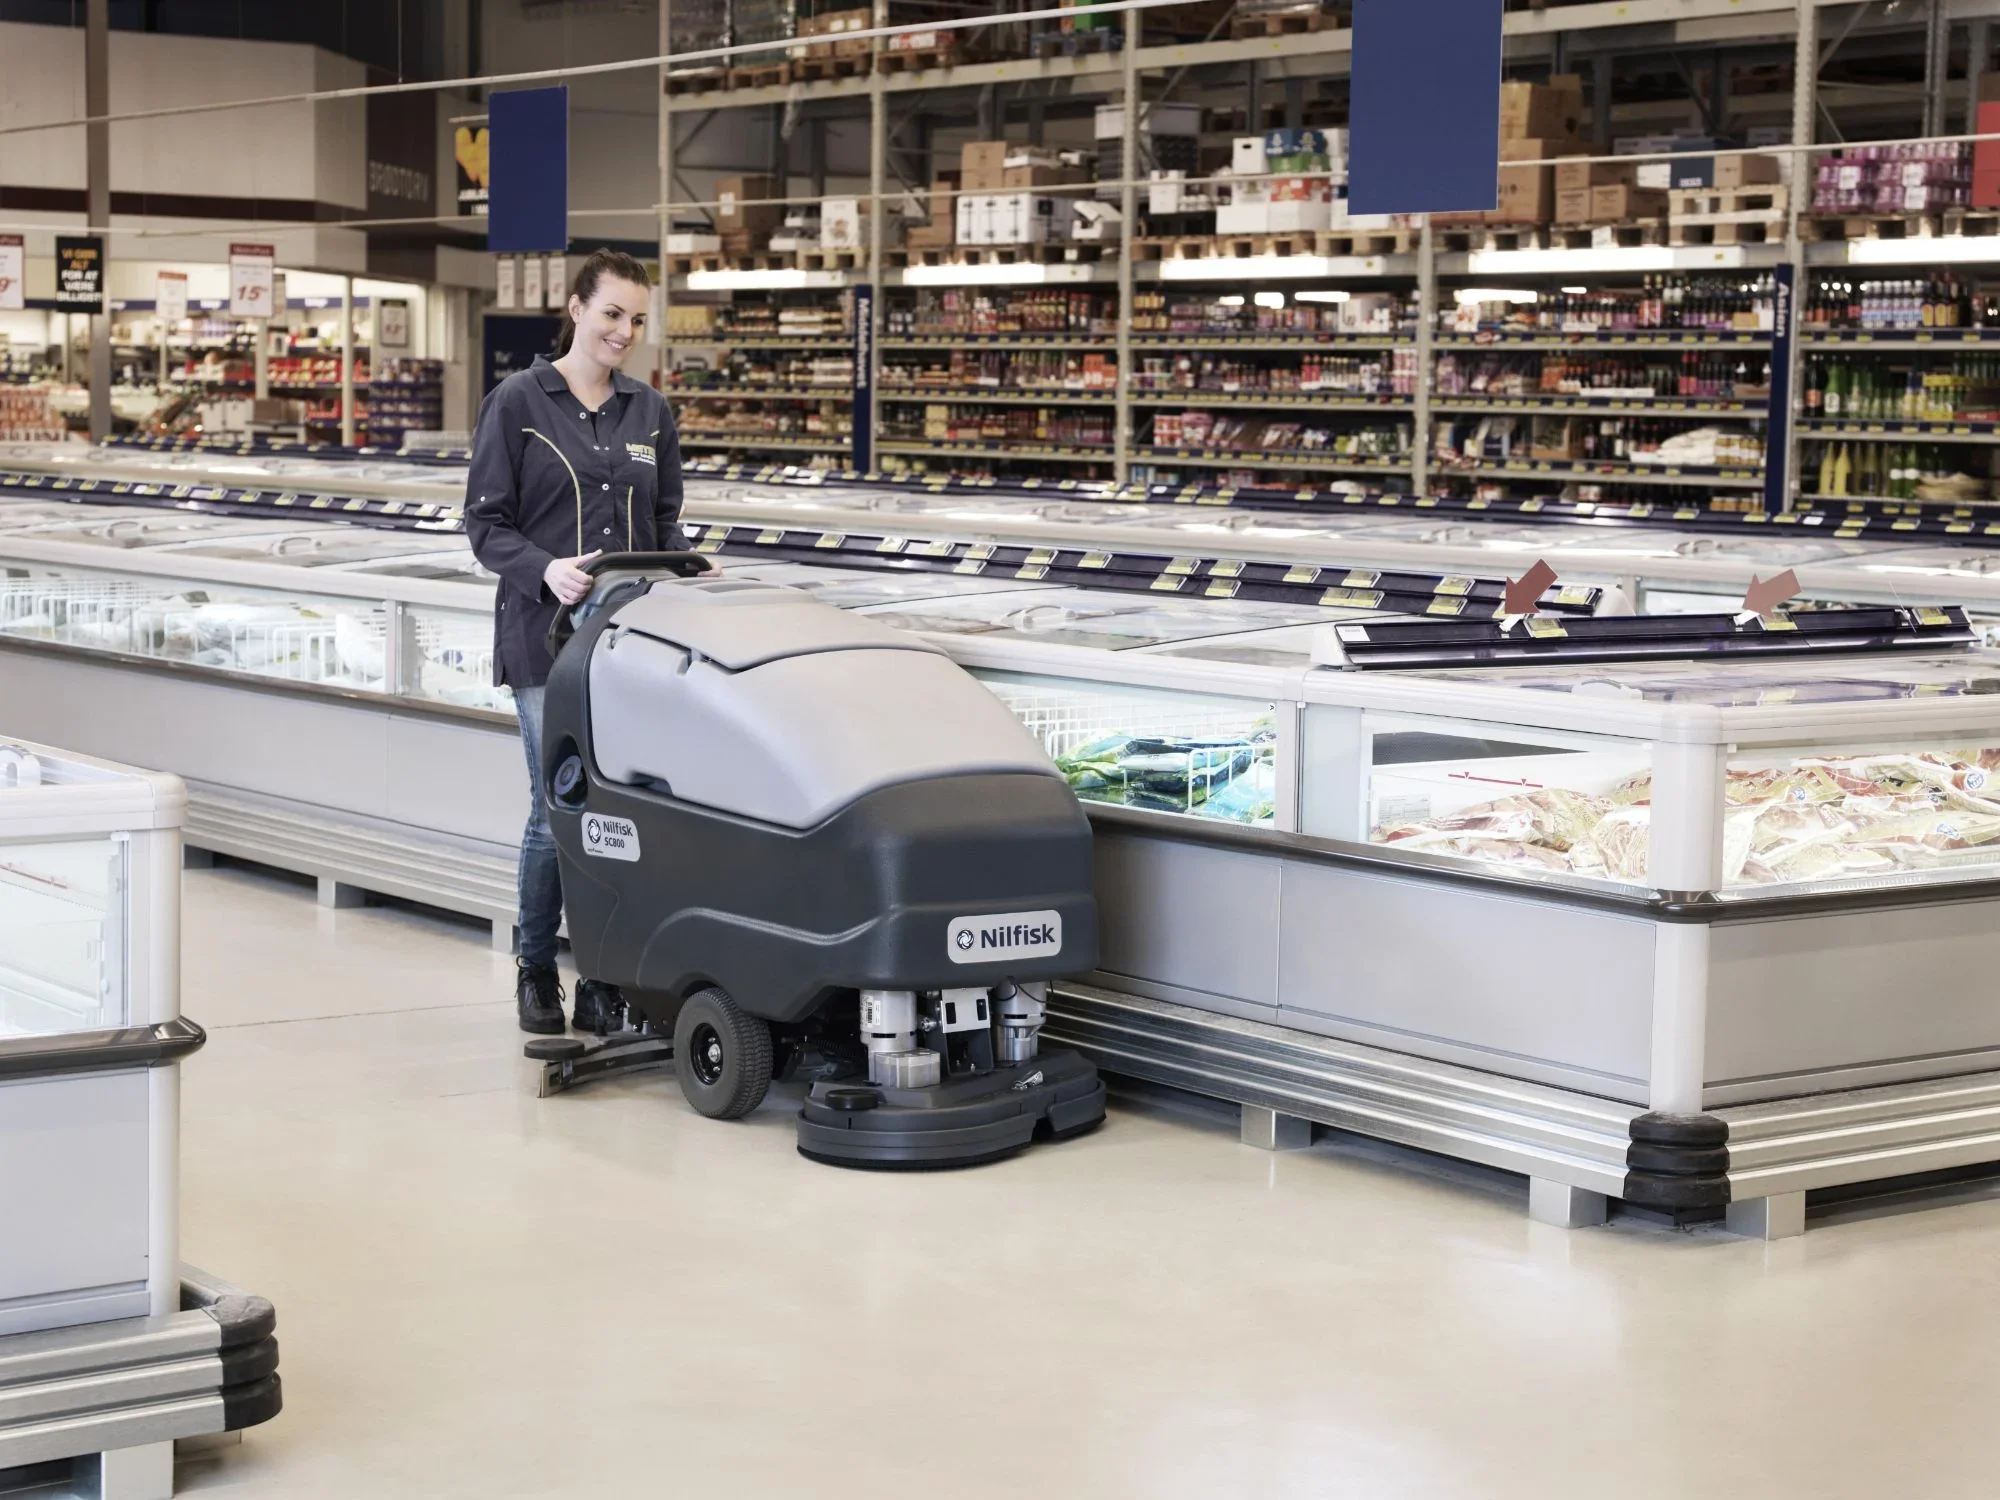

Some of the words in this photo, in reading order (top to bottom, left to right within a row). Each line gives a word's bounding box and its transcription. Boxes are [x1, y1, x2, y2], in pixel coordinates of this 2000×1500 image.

[1775, 282, 1789, 338] Asien
[603, 820, 633, 837] Nilfisk
[604, 836, 625, 849] SC800
[980, 923, 1056, 949] Nilfisk
